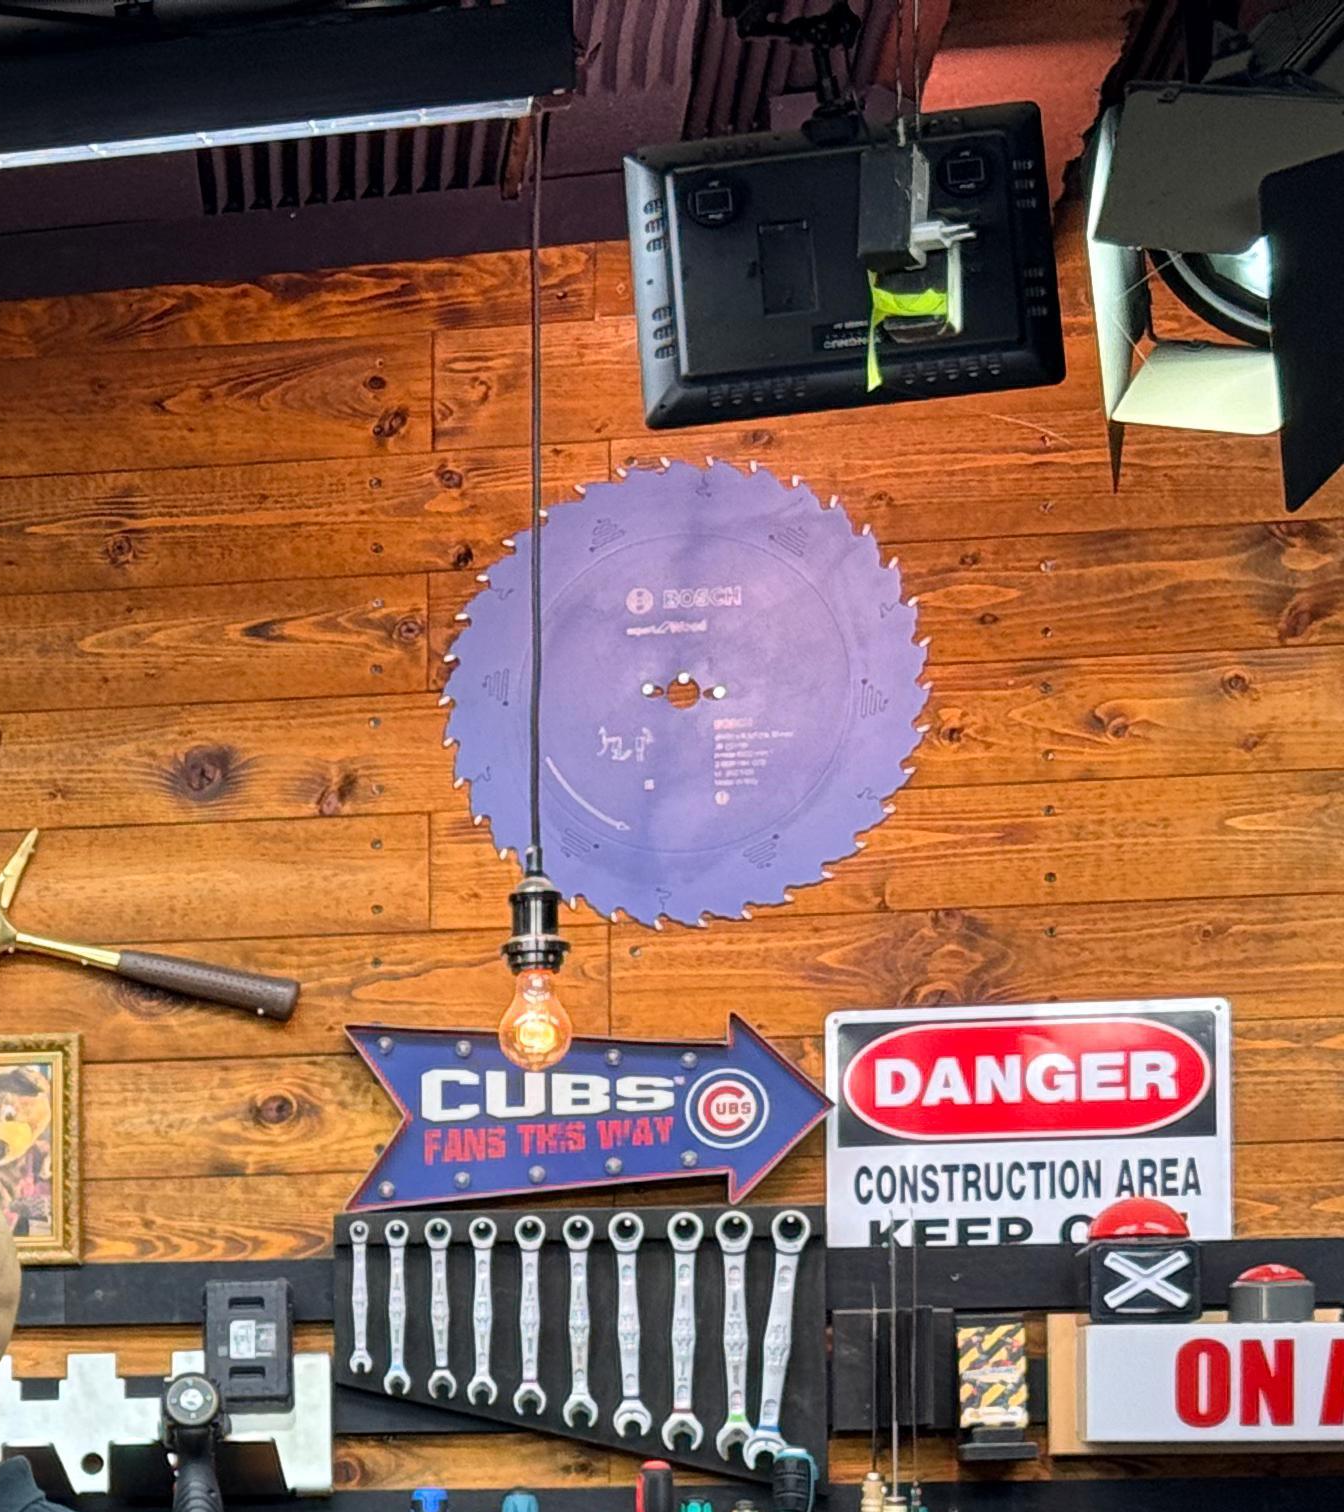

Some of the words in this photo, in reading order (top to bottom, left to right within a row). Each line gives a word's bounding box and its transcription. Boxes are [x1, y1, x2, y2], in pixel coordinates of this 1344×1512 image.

[824, 335, 882, 350] YNGNUO
[662, 585, 742, 609] BOSCH
[421, 1069, 675, 1122] CUBS
[874, 1050, 1180, 1107] DANGER
[424, 1126, 506, 1166] FANS
[517, 1120, 586, 1157] THIS
[597, 1116, 675, 1150] WAY
[854, 1160, 1102, 1205] CONSTRUCTION
[1115, 1157, 1202, 1200] AREA
[1175, 1338, 1295, 1428] ON
